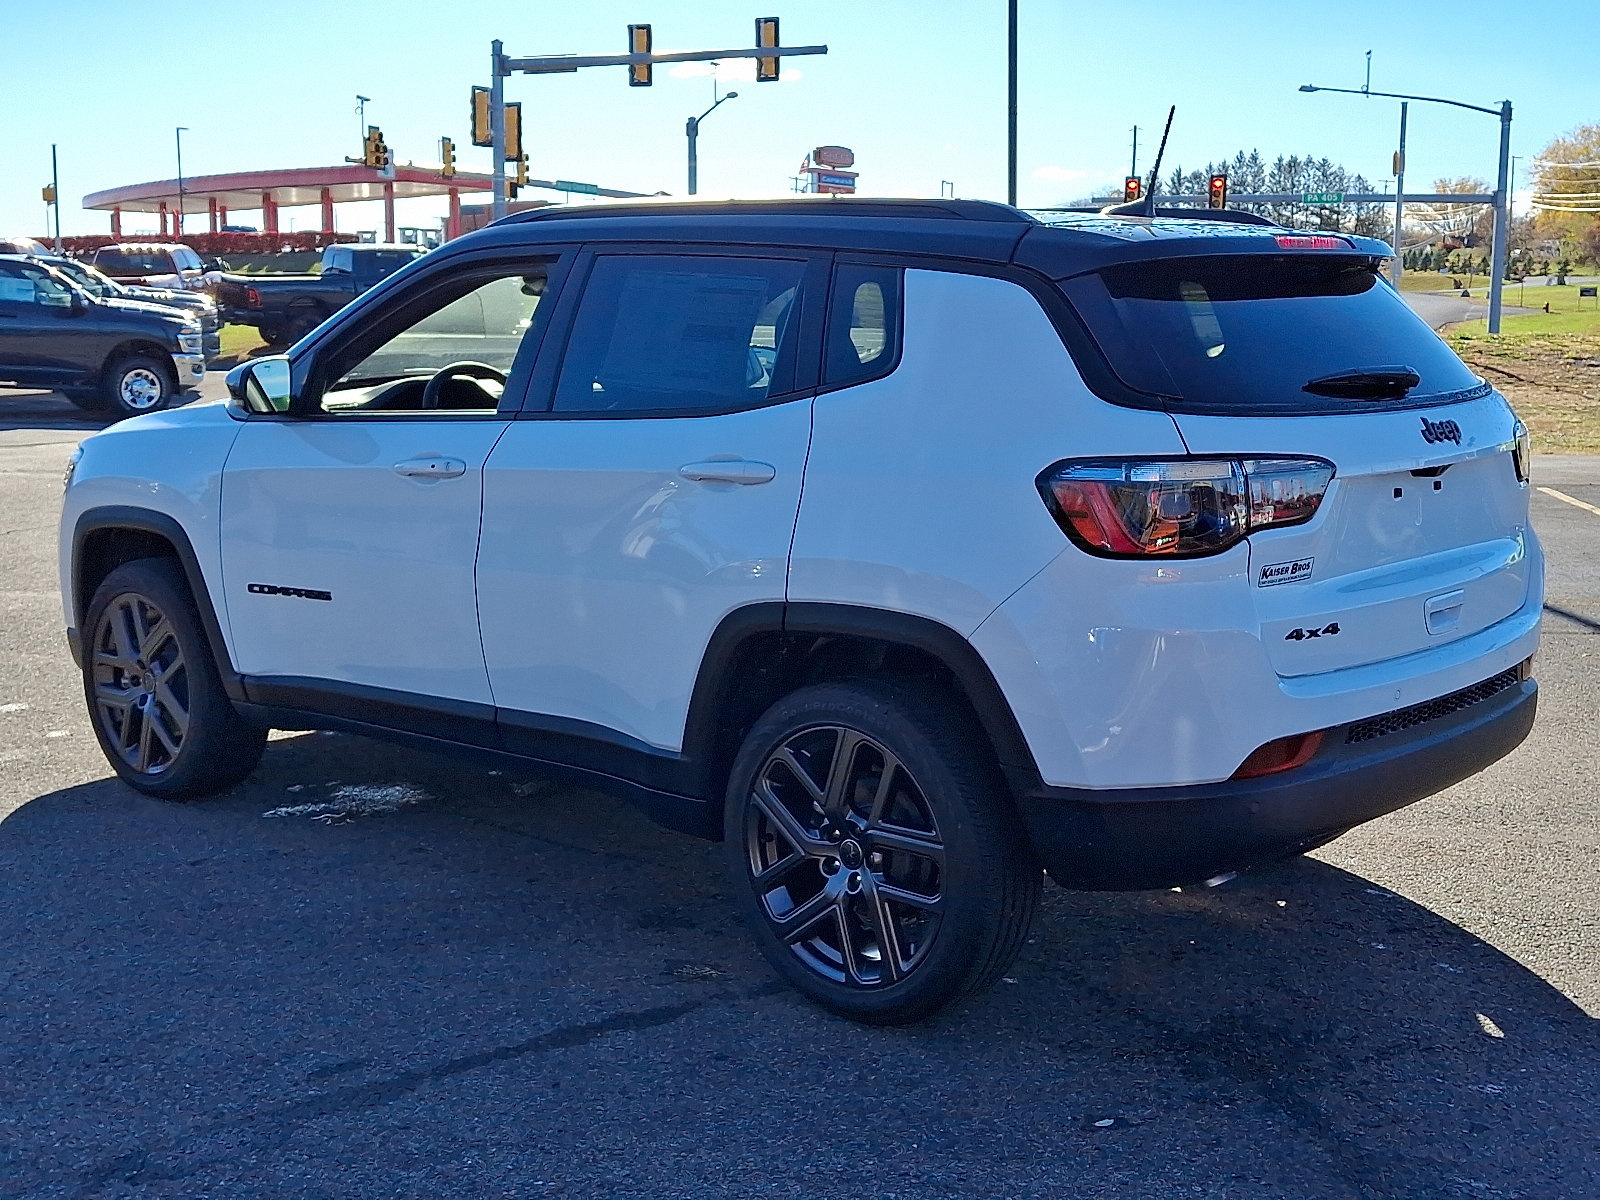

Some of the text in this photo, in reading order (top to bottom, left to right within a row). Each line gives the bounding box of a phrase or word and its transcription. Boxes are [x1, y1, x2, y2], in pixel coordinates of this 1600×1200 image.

[1308, 194, 1338, 202] PA 405
[1420, 416, 1462, 446] Jeep
[1261, 566, 1289, 580] KAISER
[1290, 562, 1310, 575] BROS
[1285, 623, 1341, 641] 4x4
